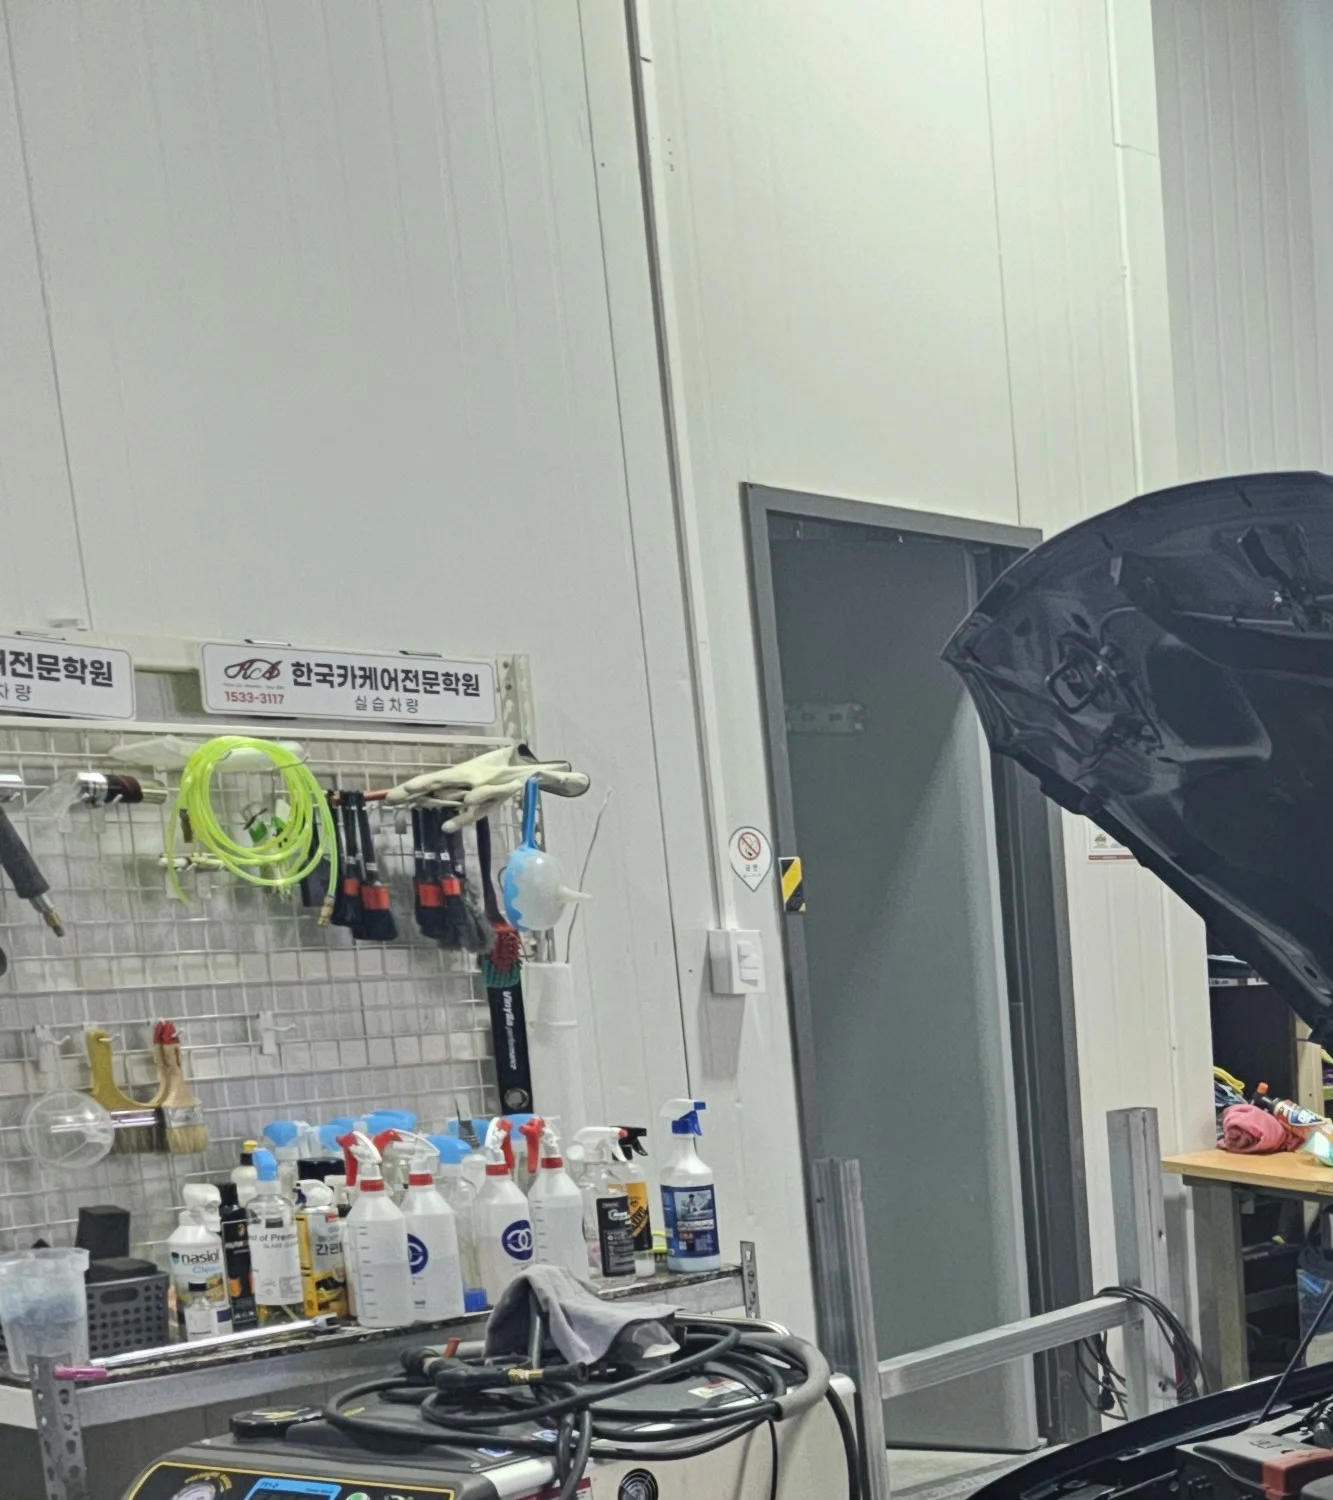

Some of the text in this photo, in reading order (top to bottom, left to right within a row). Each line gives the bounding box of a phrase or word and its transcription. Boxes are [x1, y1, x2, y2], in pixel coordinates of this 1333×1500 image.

[291, 661, 481, 697] 한국카케어전문학원
[225, 690, 285, 705] 1533-3117
[181, 1249, 220, 1264] nasiol
